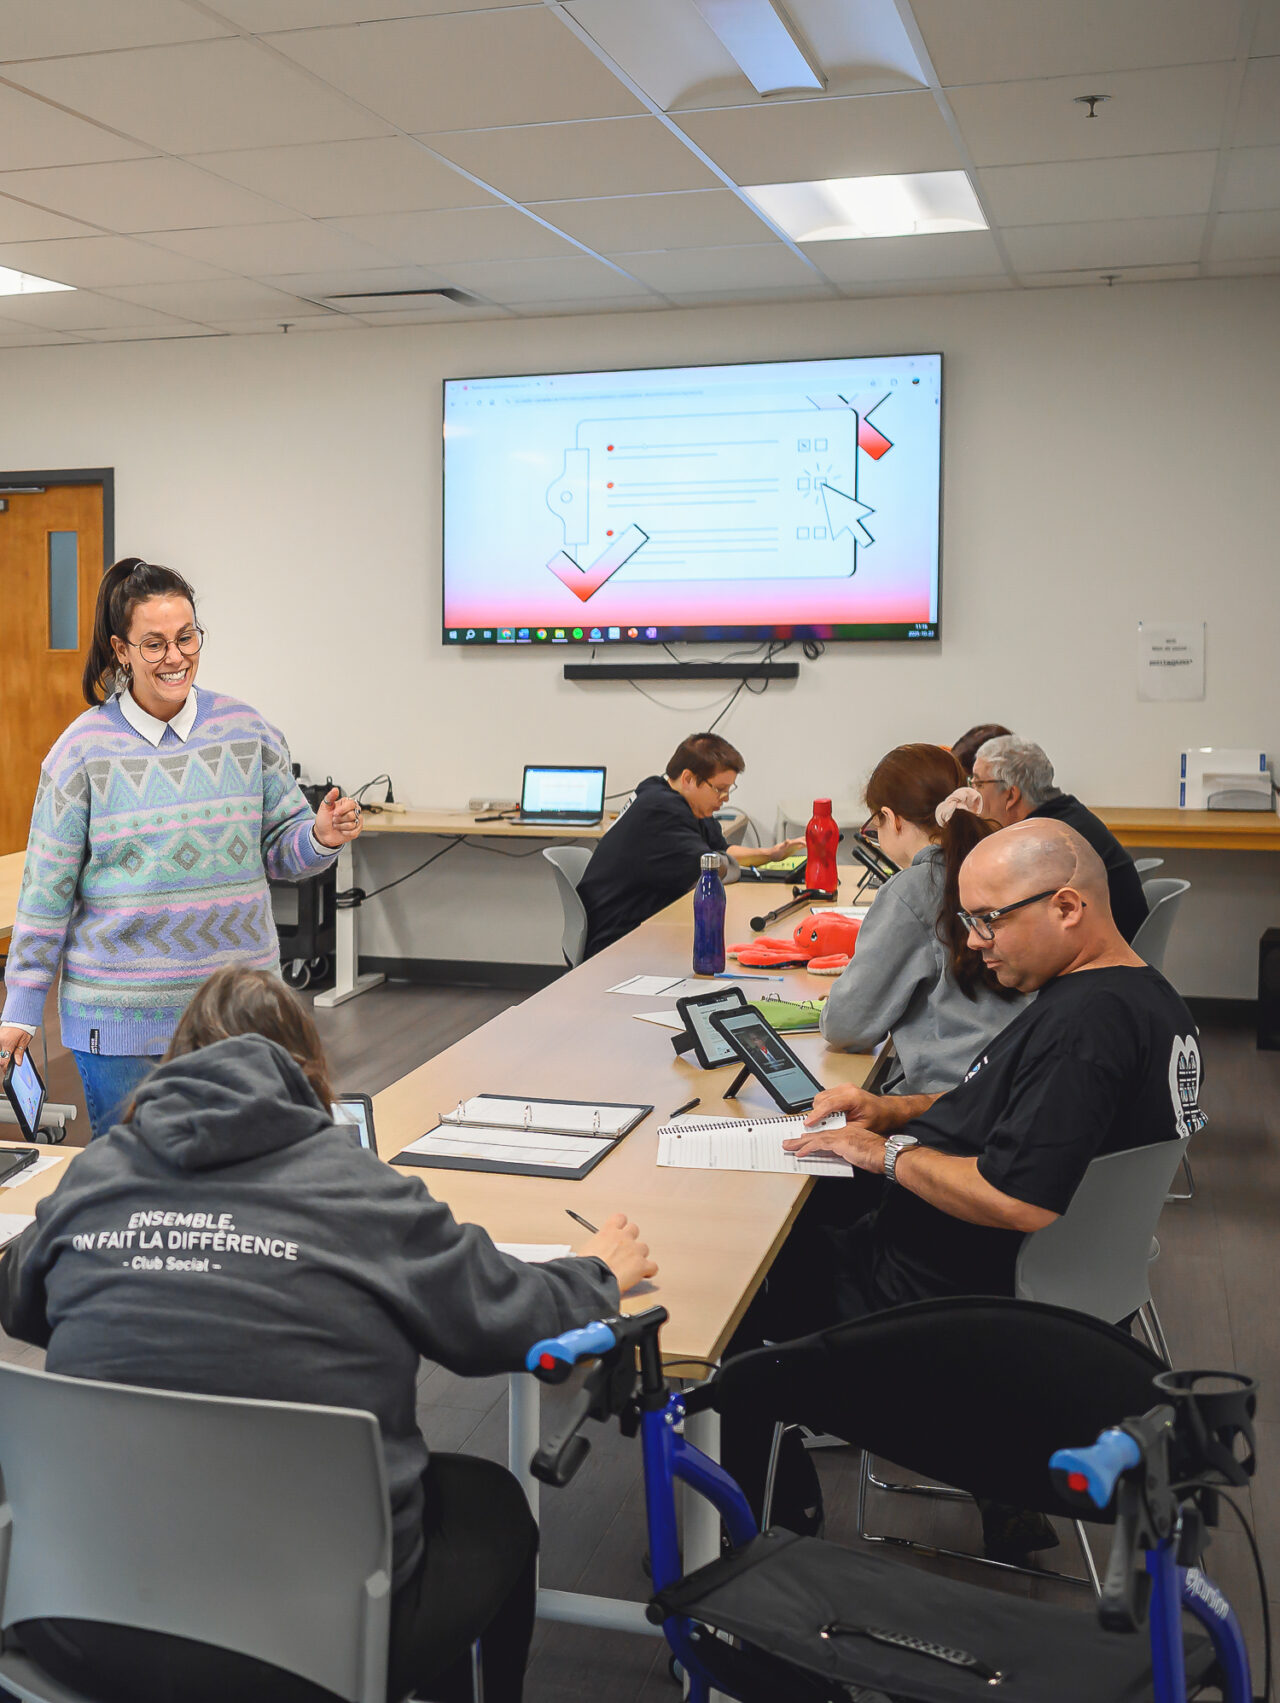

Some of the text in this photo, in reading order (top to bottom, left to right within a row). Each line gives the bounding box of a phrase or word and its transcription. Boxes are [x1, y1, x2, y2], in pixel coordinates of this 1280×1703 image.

[72, 1229, 299, 1261] ON FAIT LA DIFFÉRENCE
[131, 1256, 164, 1271] Club
[166, 1256, 210, 1272] Social
